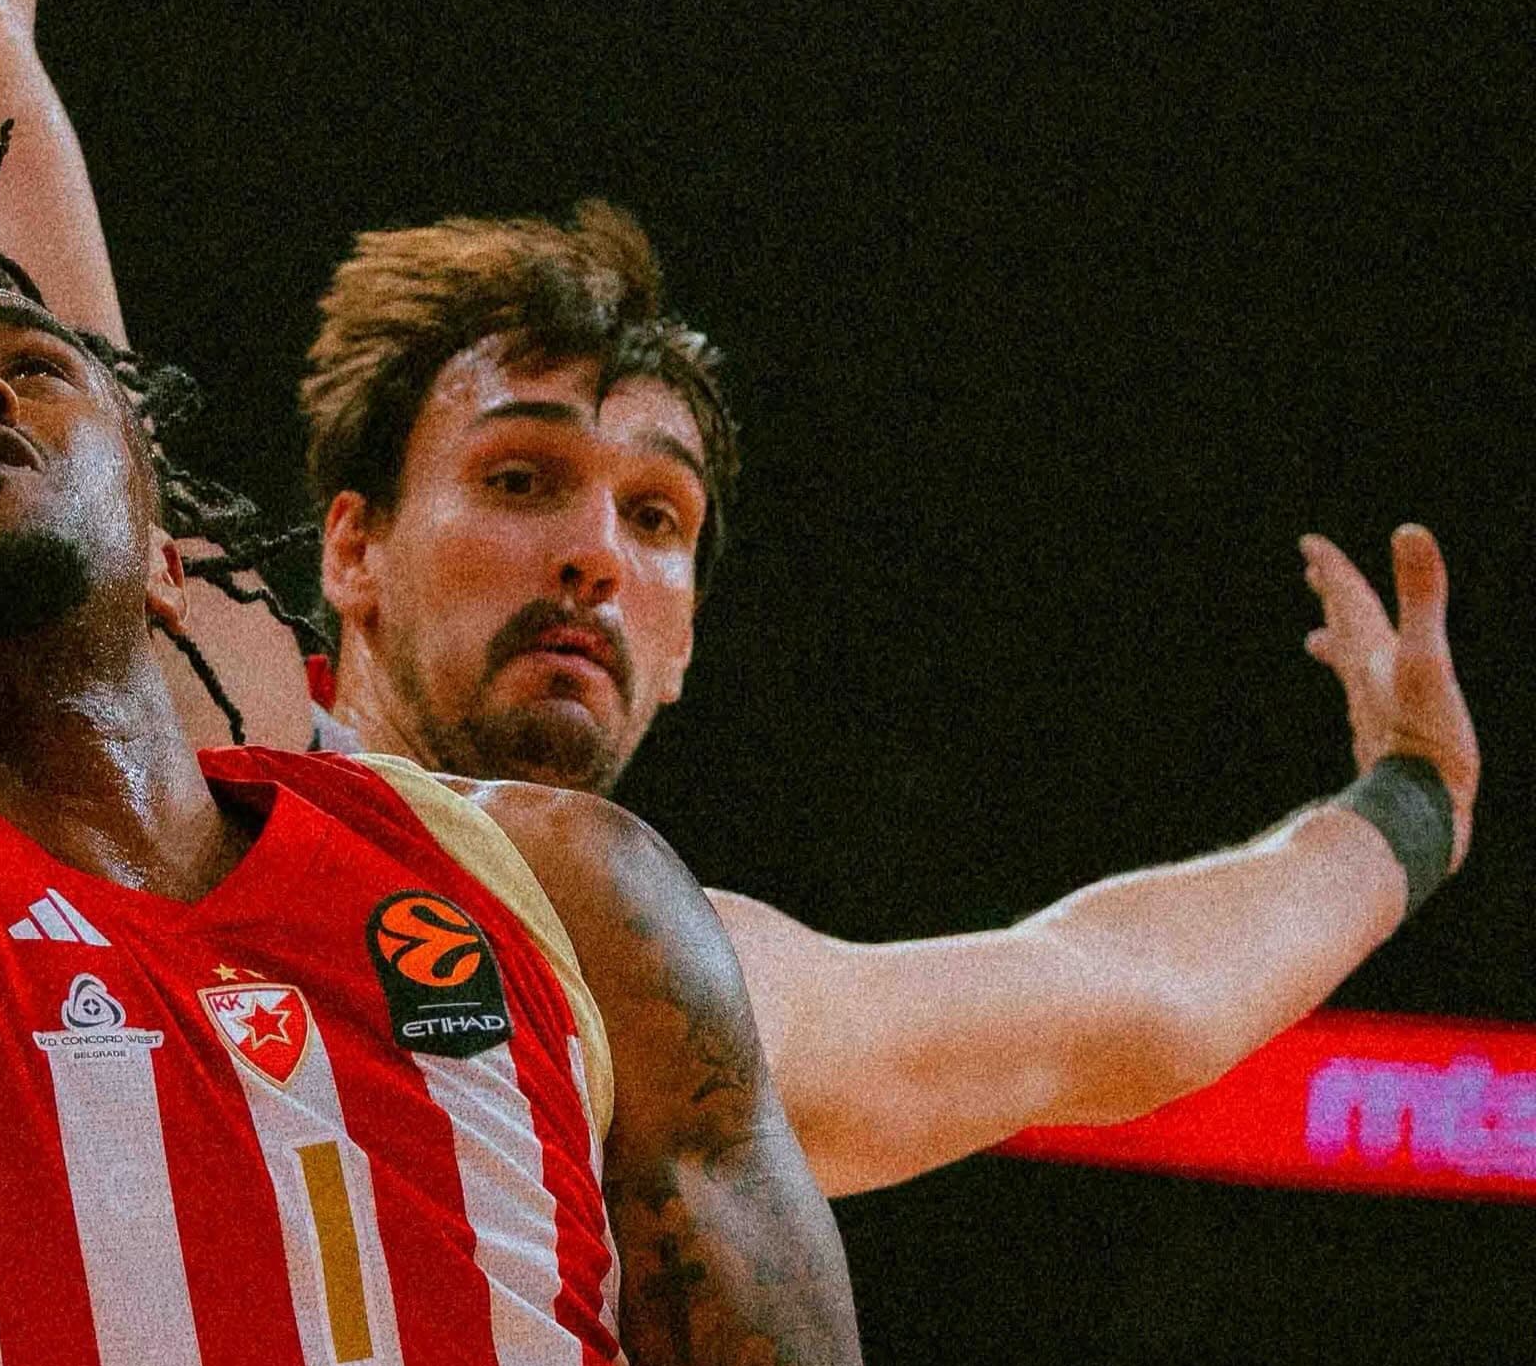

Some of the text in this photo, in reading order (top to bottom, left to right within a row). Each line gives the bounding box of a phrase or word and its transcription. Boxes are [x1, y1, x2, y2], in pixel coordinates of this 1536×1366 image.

[212, 993, 245, 1013] KK
[402, 1012, 506, 1040] ETIHAD
[61, 1034, 123, 1046] CONCORD
[126, 1034, 161, 1045] WEST
[74, 1049, 127, 1060] BELGRADE
